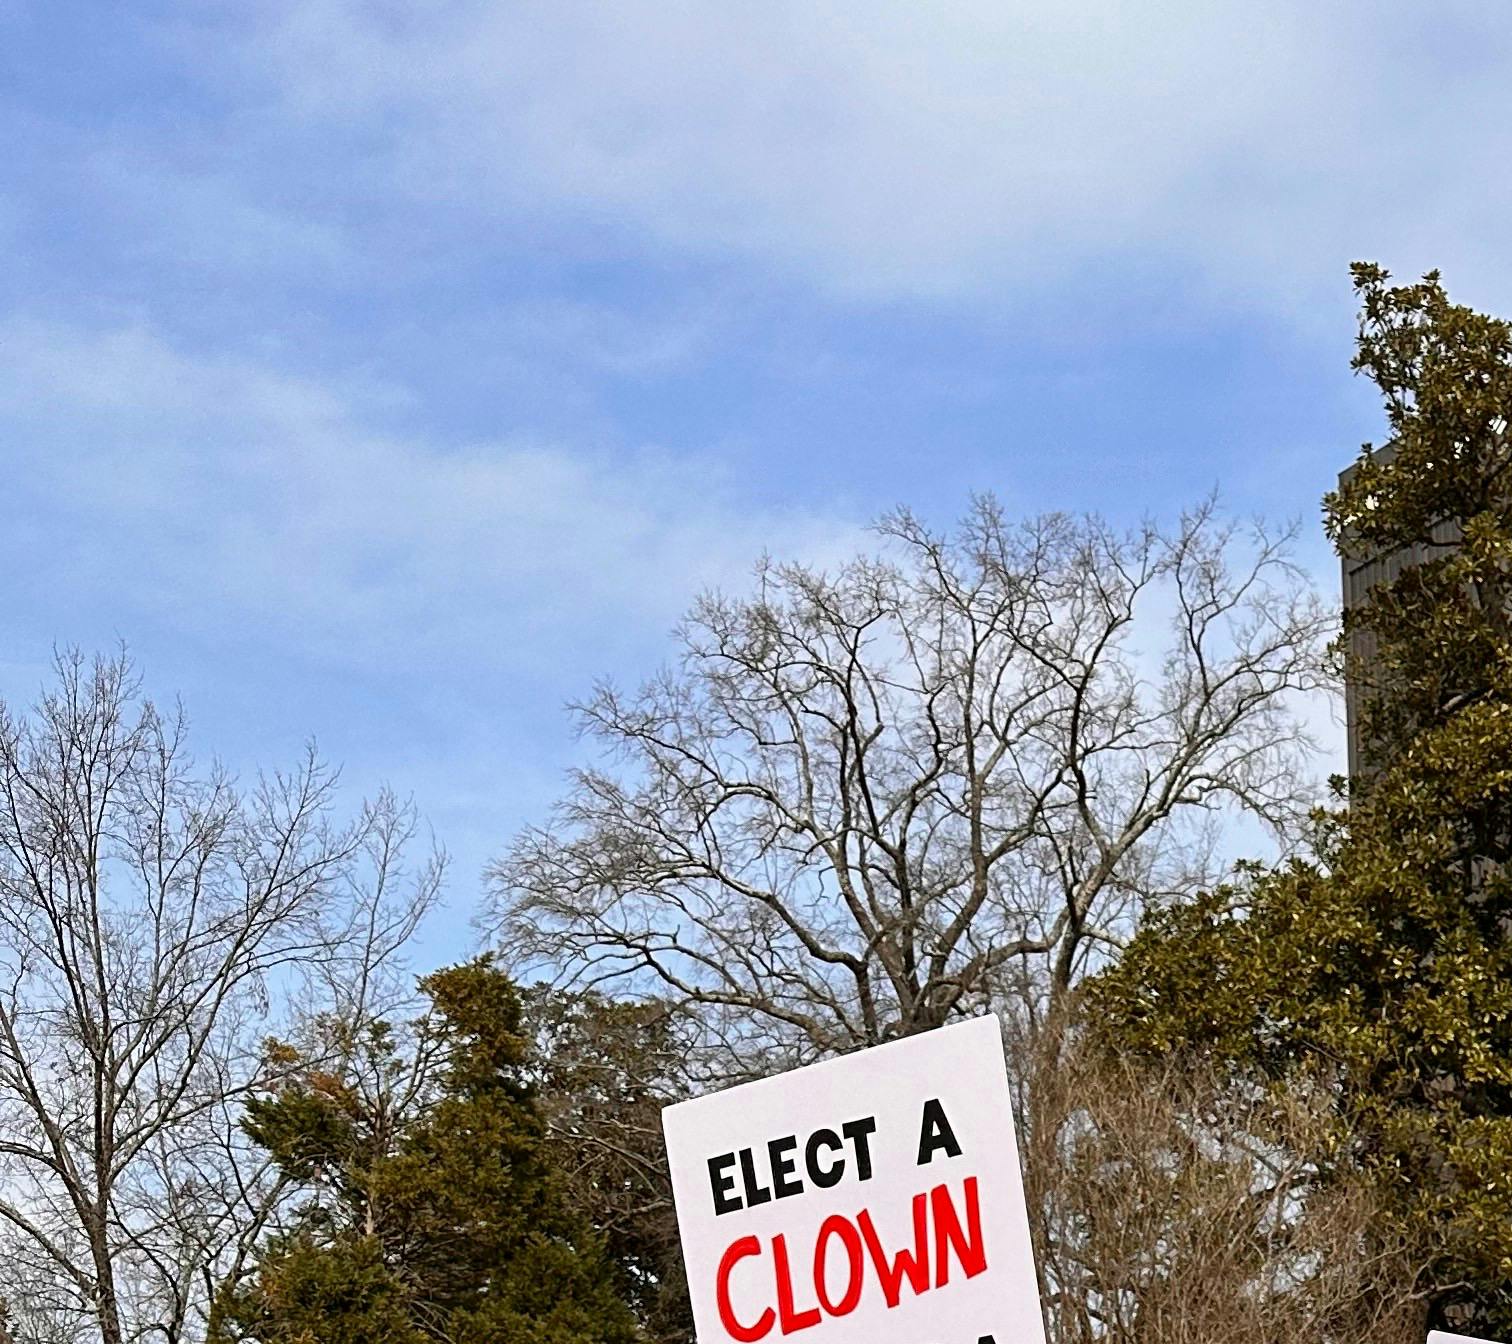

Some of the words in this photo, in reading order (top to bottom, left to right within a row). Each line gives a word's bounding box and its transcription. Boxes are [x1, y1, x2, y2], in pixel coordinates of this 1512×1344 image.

[707, 1116, 876, 1216] ELECT
[917, 1099, 962, 1165] A
[716, 1176, 987, 1343] CLOWN
